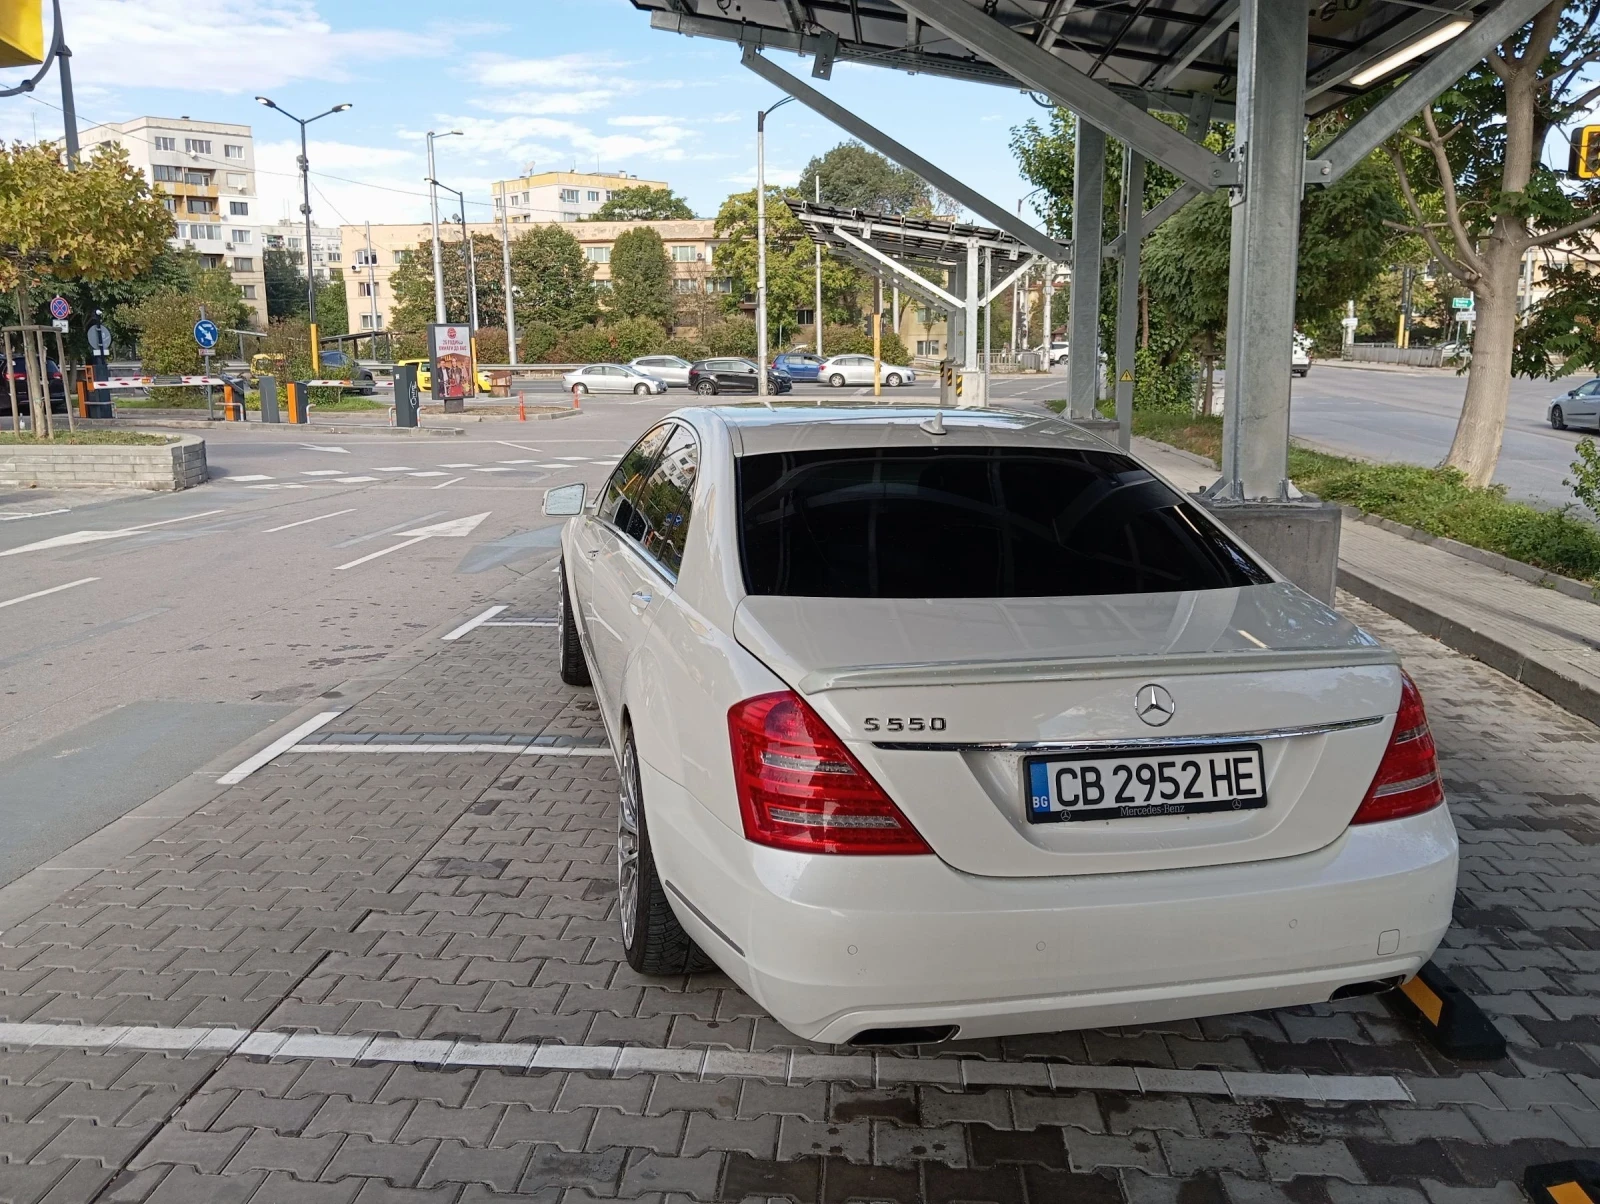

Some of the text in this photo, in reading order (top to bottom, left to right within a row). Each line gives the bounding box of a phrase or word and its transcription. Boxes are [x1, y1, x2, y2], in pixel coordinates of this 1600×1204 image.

[1055, 757, 1257, 807] CB 2952 HE
[1032, 796, 1048, 809] BG
[1120, 804, 1186, 817] Mercedes-Benz
